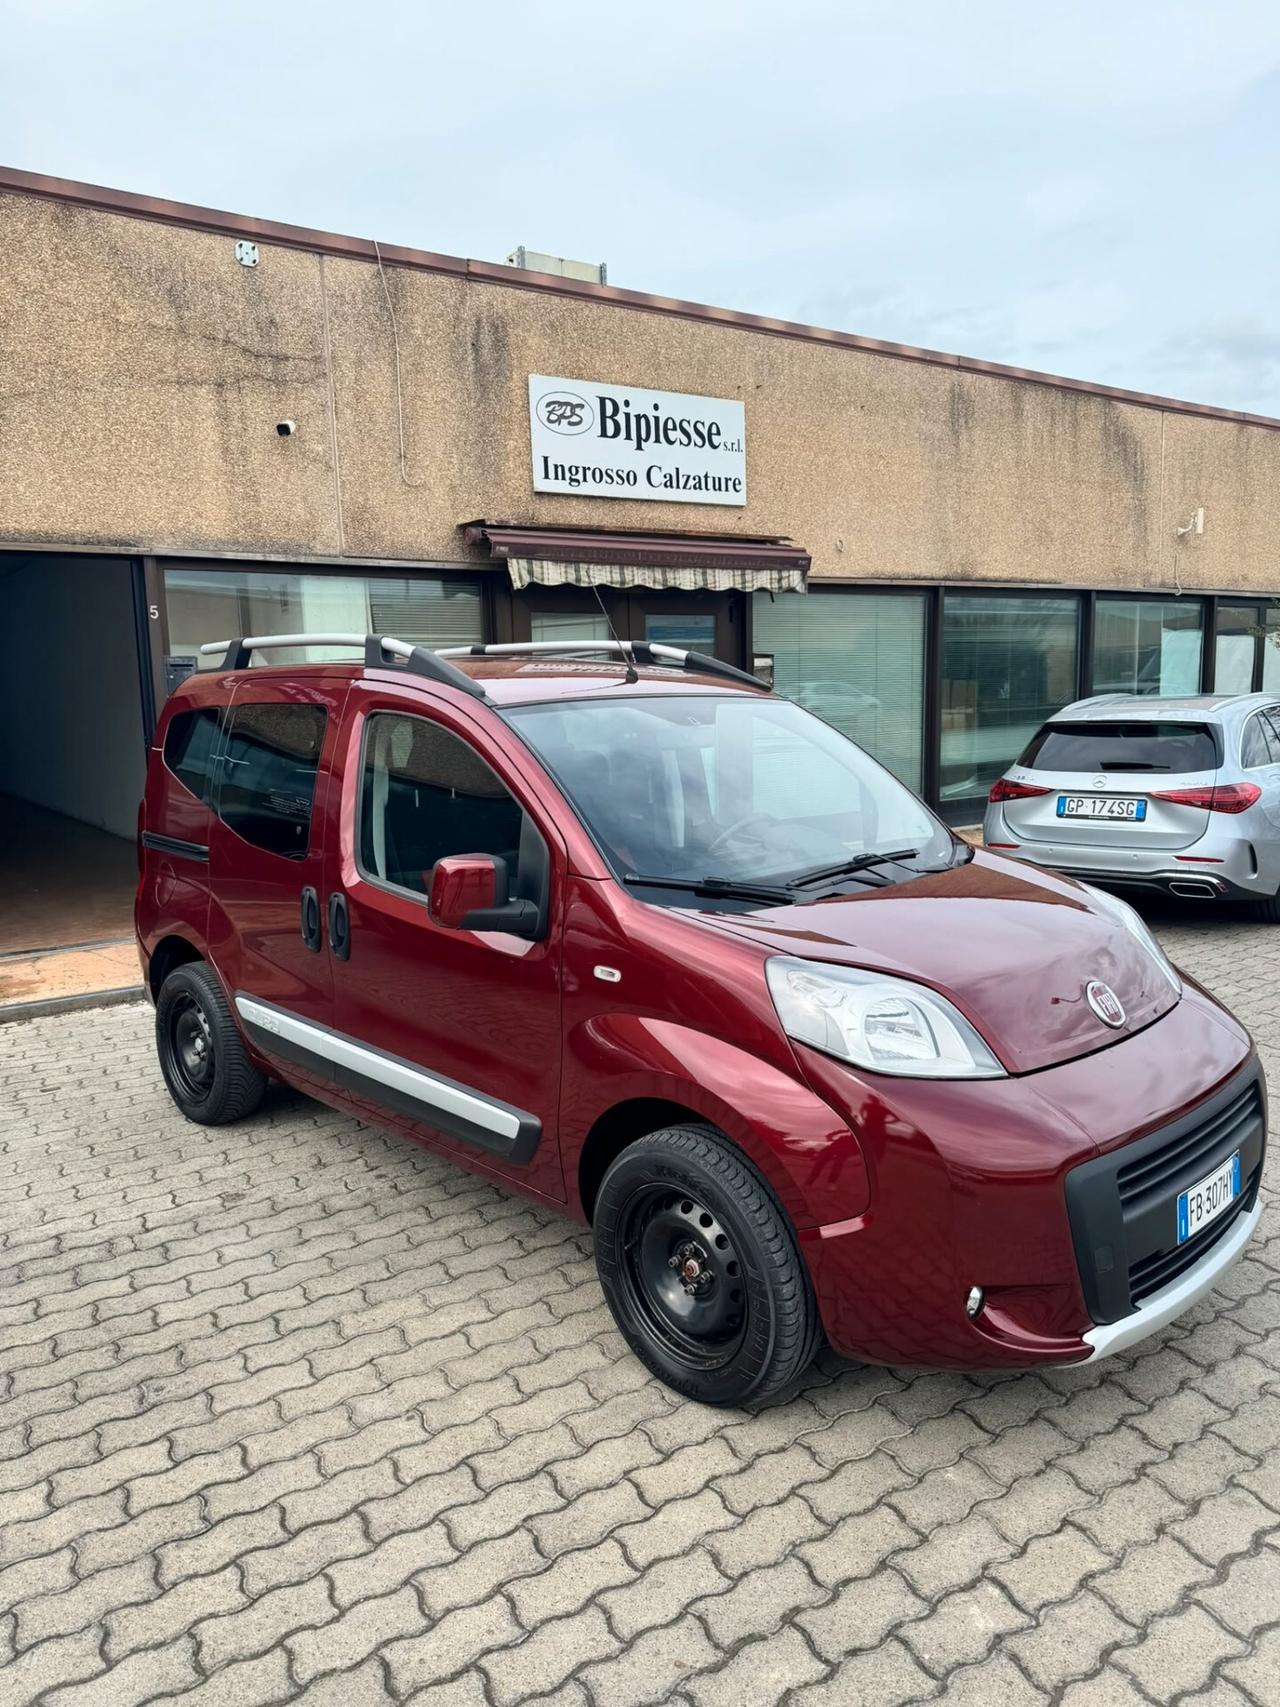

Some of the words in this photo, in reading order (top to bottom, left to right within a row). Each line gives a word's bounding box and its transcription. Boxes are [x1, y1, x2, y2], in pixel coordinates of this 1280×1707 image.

[595, 395, 722, 451] Bipiesse
[723, 438, 744, 453] s.r.l.
[541, 455, 638, 488] Ingrosso
[646, 465, 742, 493] Calzature
[149, 604, 159, 619] 5
